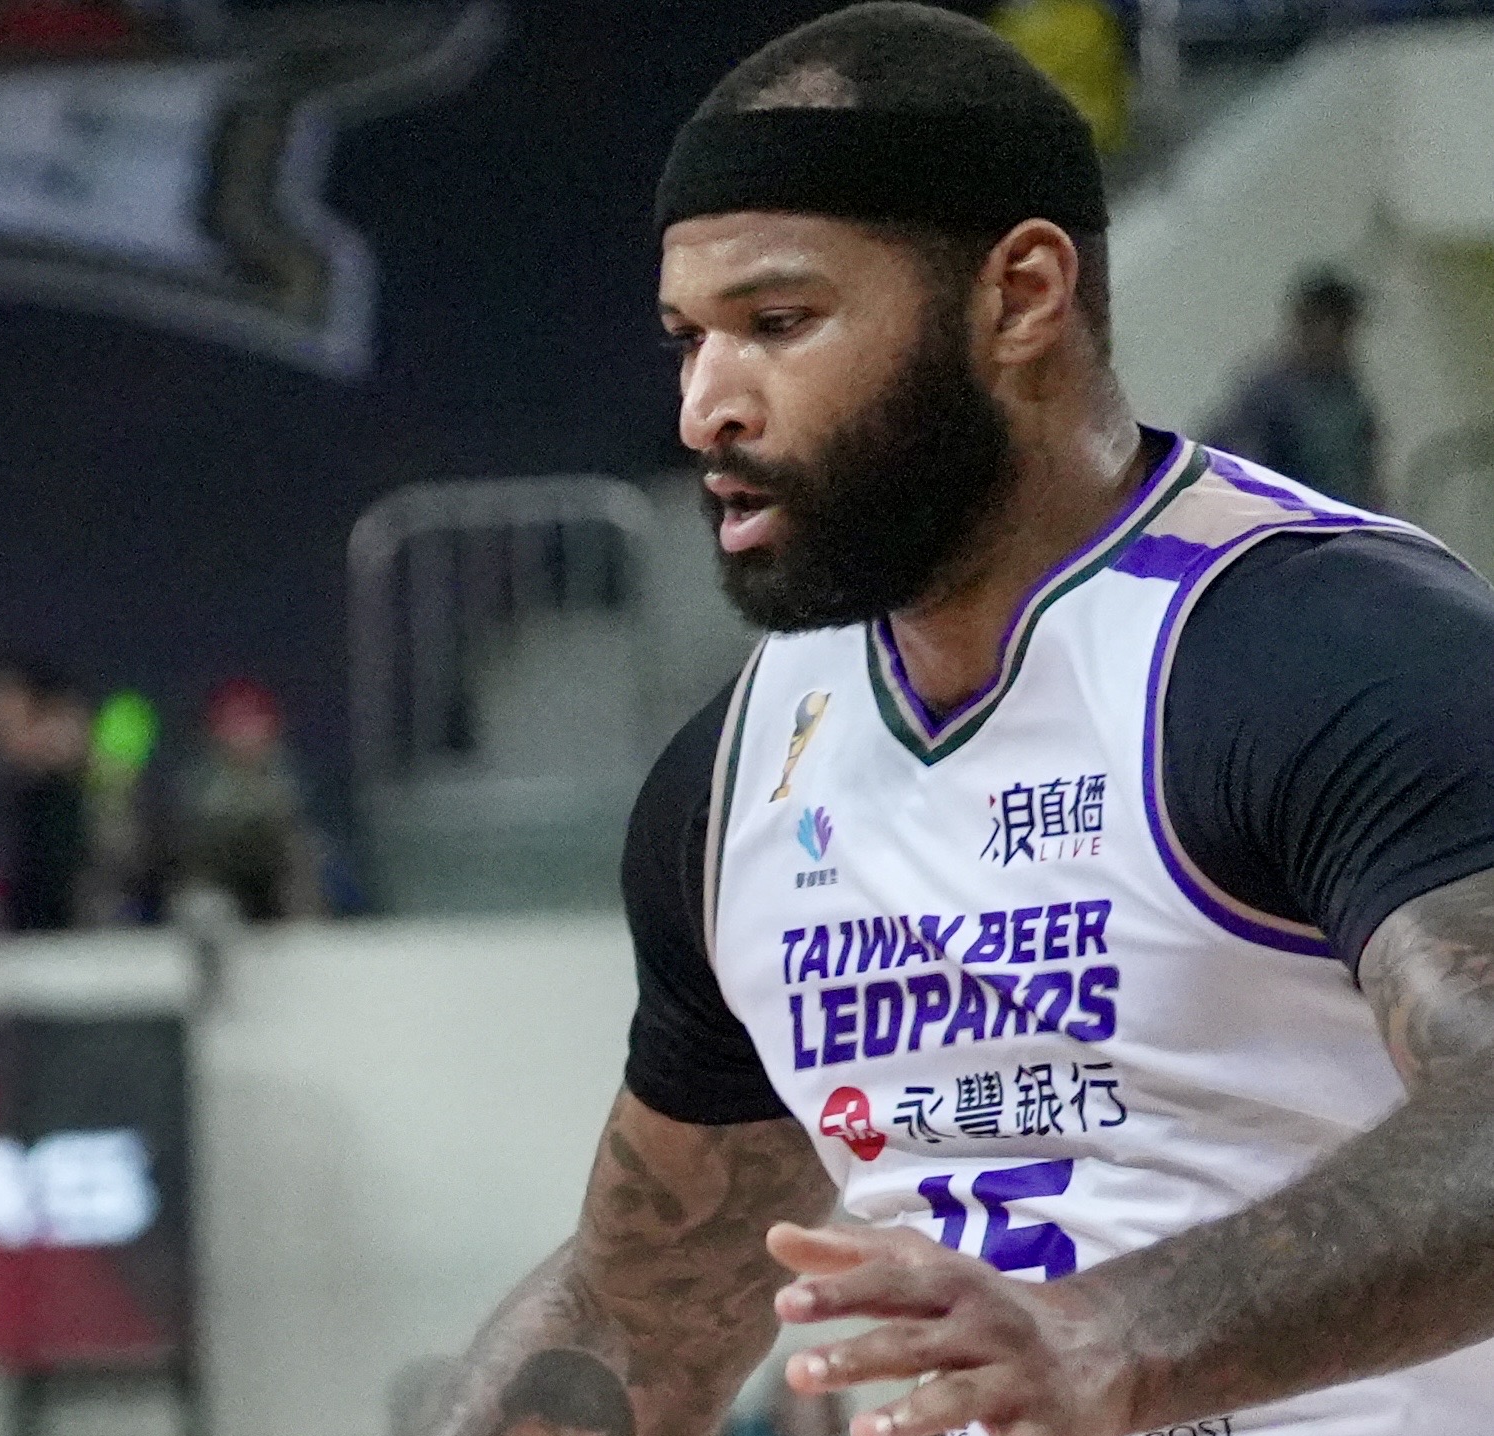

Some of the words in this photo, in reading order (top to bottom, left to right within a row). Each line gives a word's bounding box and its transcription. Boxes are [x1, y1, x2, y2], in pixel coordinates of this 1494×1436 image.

[979, 773, 1109, 868] 浪直播
[1039, 836, 1103, 862] LIVE
[962, 899, 1113, 965] BEER
[893, 1061, 1128, 1144] 永豐銀行
[918, 1157, 1078, 1282] 15
